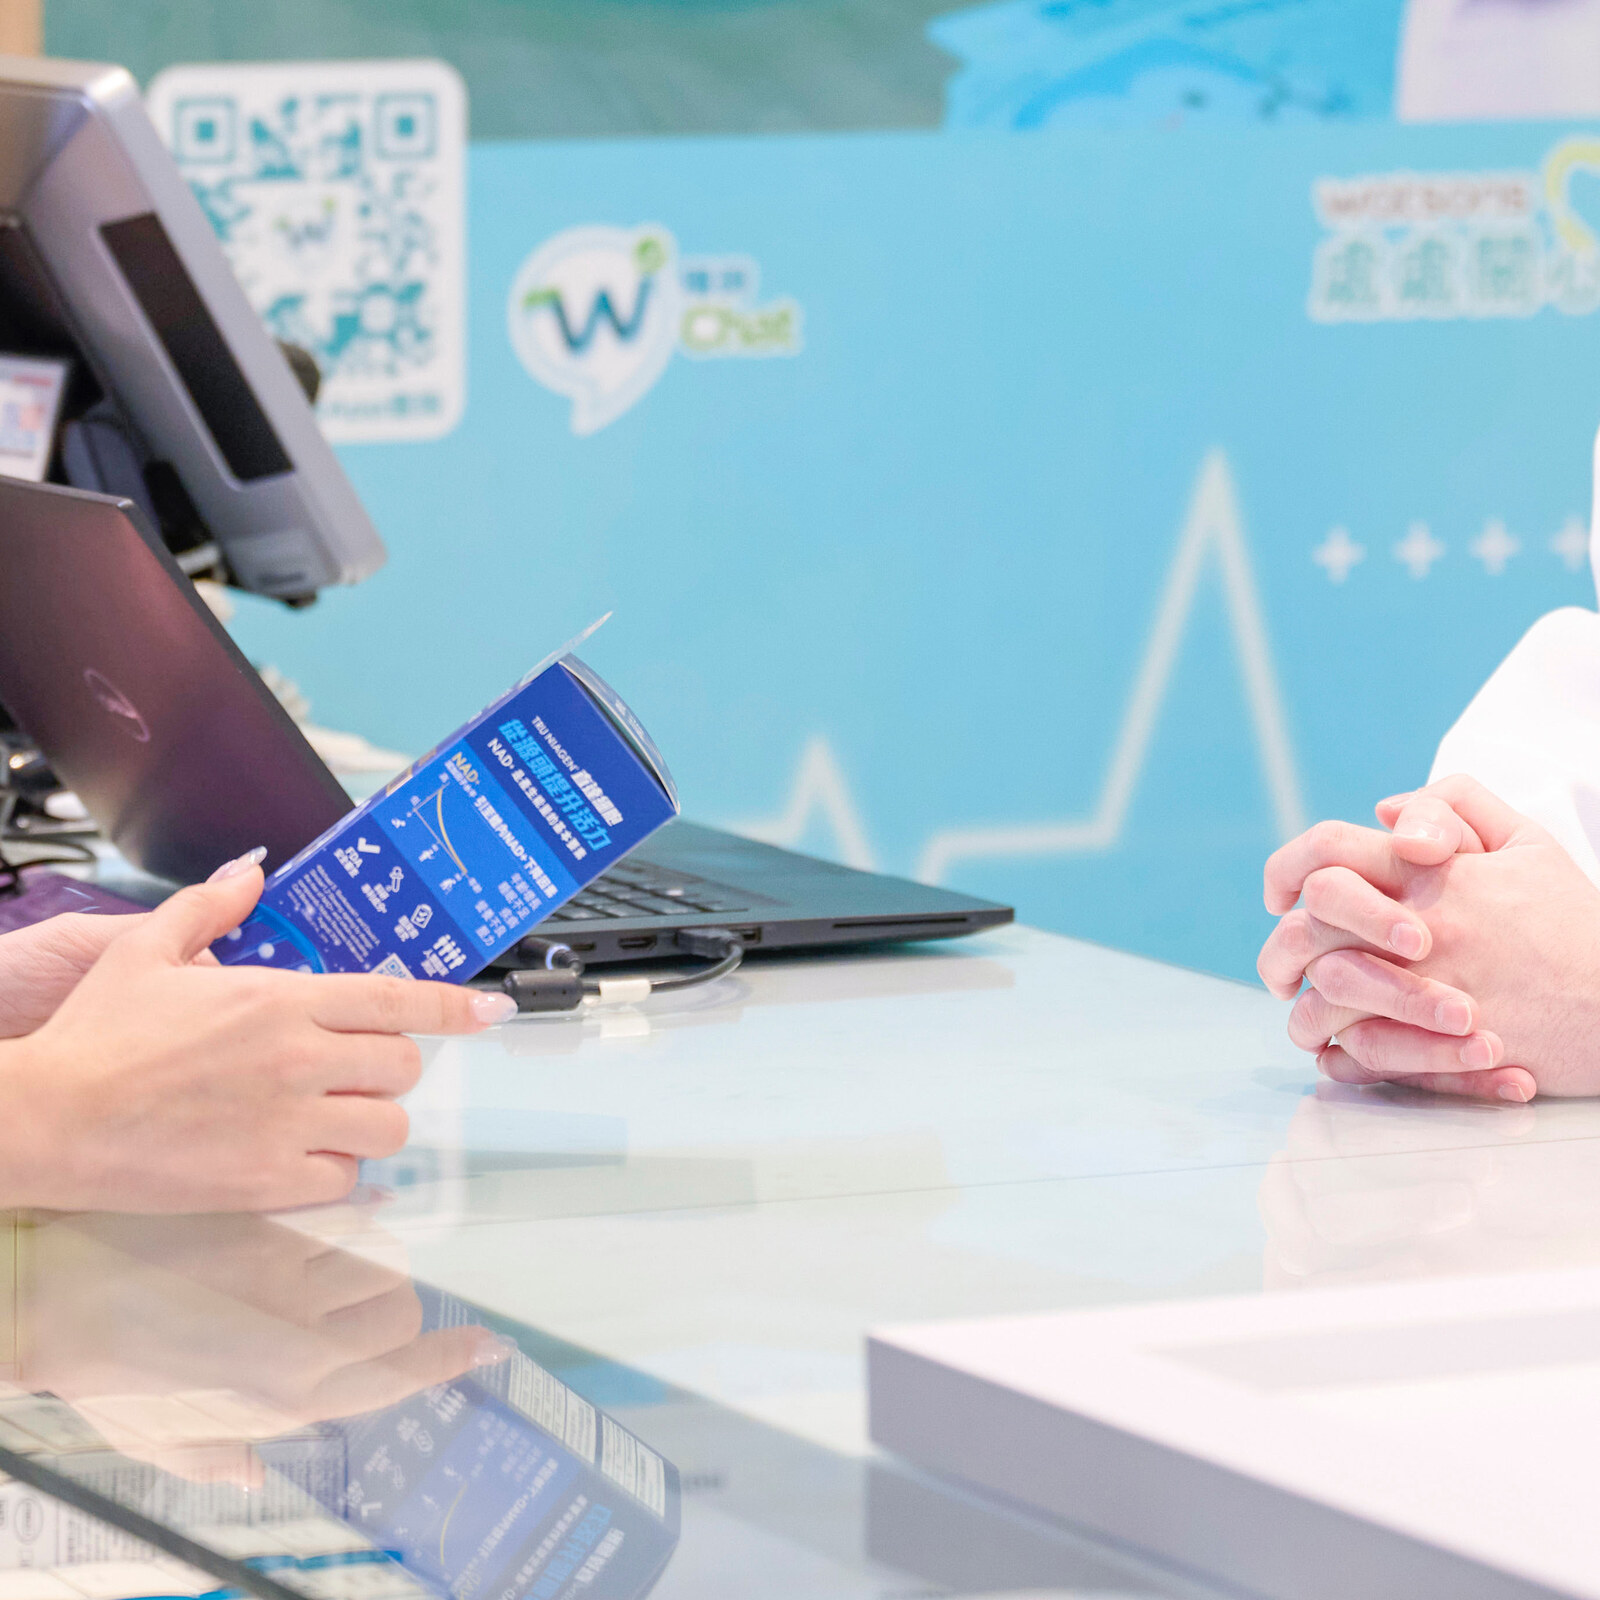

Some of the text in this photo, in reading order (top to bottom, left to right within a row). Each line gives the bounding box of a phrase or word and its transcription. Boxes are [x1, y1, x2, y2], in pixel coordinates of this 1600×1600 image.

[499, 718, 612, 851] 從源頭提升活力
[510, 767, 588, 861] 是產生能量的基本要素
[530, 715, 549, 736] TRU
[570, 766, 624, 827] 直達細胞
[344, 845, 365, 869] FDA
